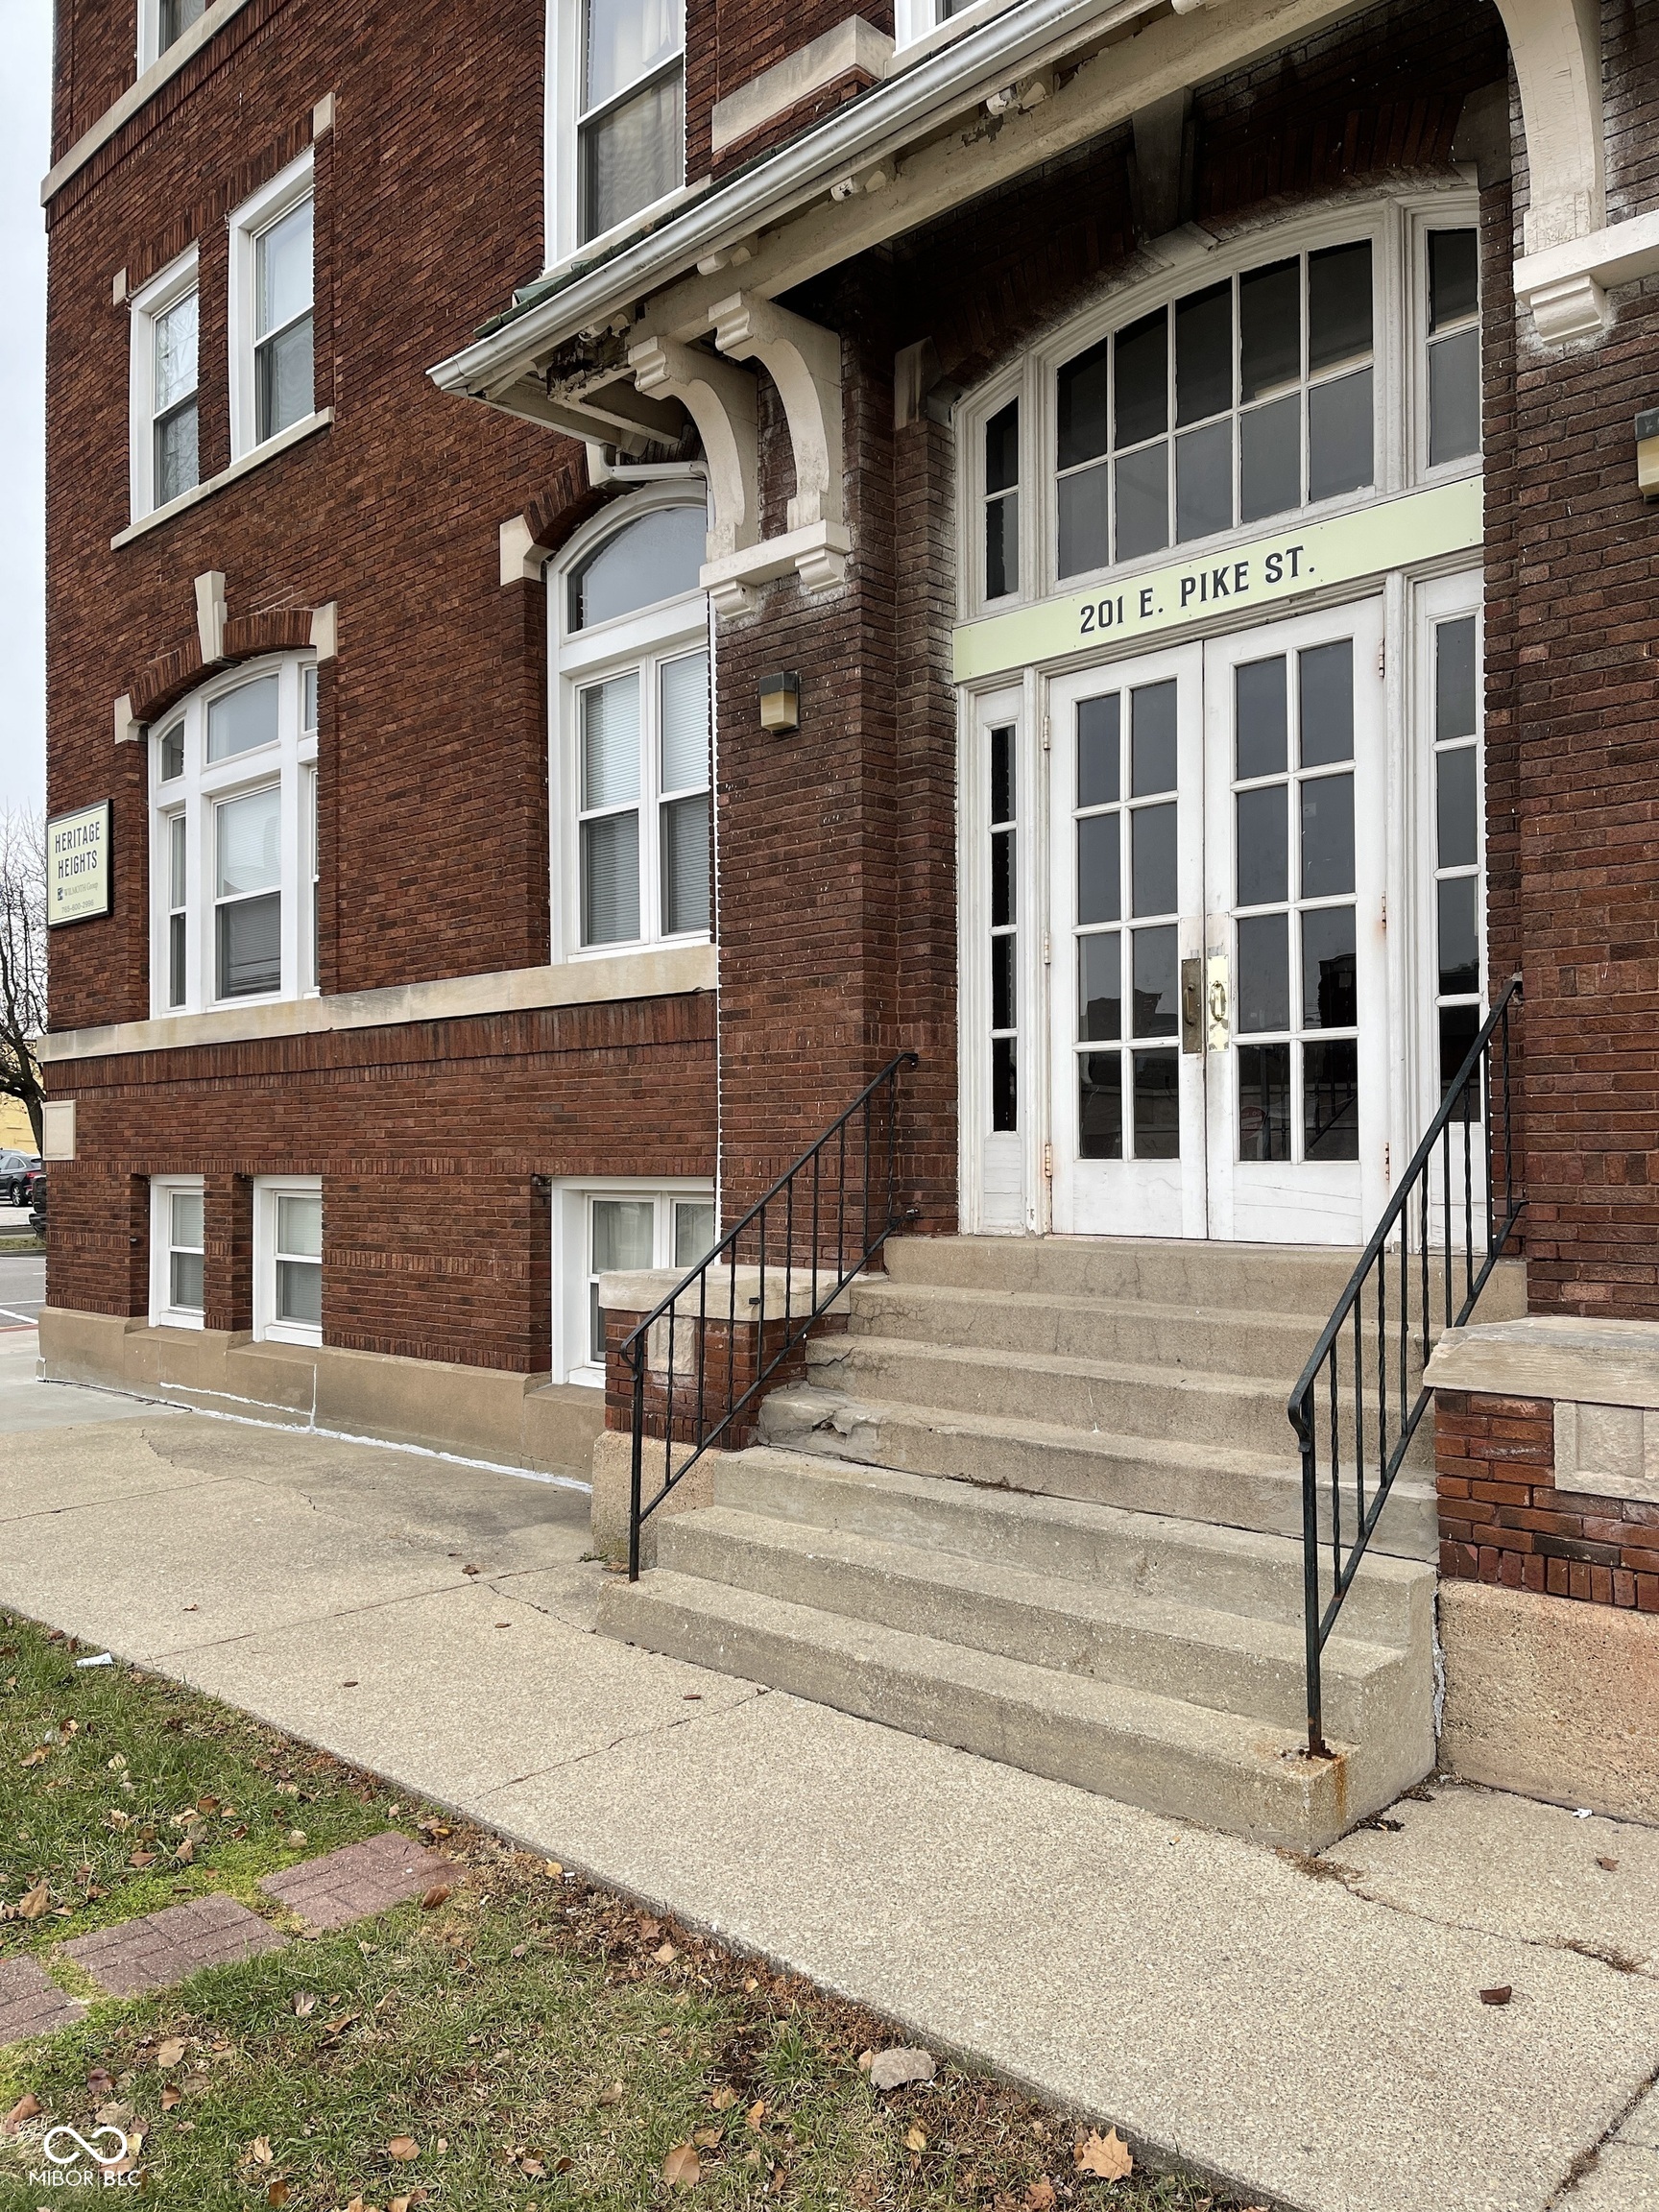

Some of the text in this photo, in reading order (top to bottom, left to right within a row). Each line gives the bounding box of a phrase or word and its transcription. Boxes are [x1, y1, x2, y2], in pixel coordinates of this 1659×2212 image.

[1080, 545, 1315, 634] 201 E. PIKE ST.
[55, 821, 100, 854] HERITAGE
[58, 850, 98, 879] HEIGHTS
[64, 883, 86, 896] WILMOTH
